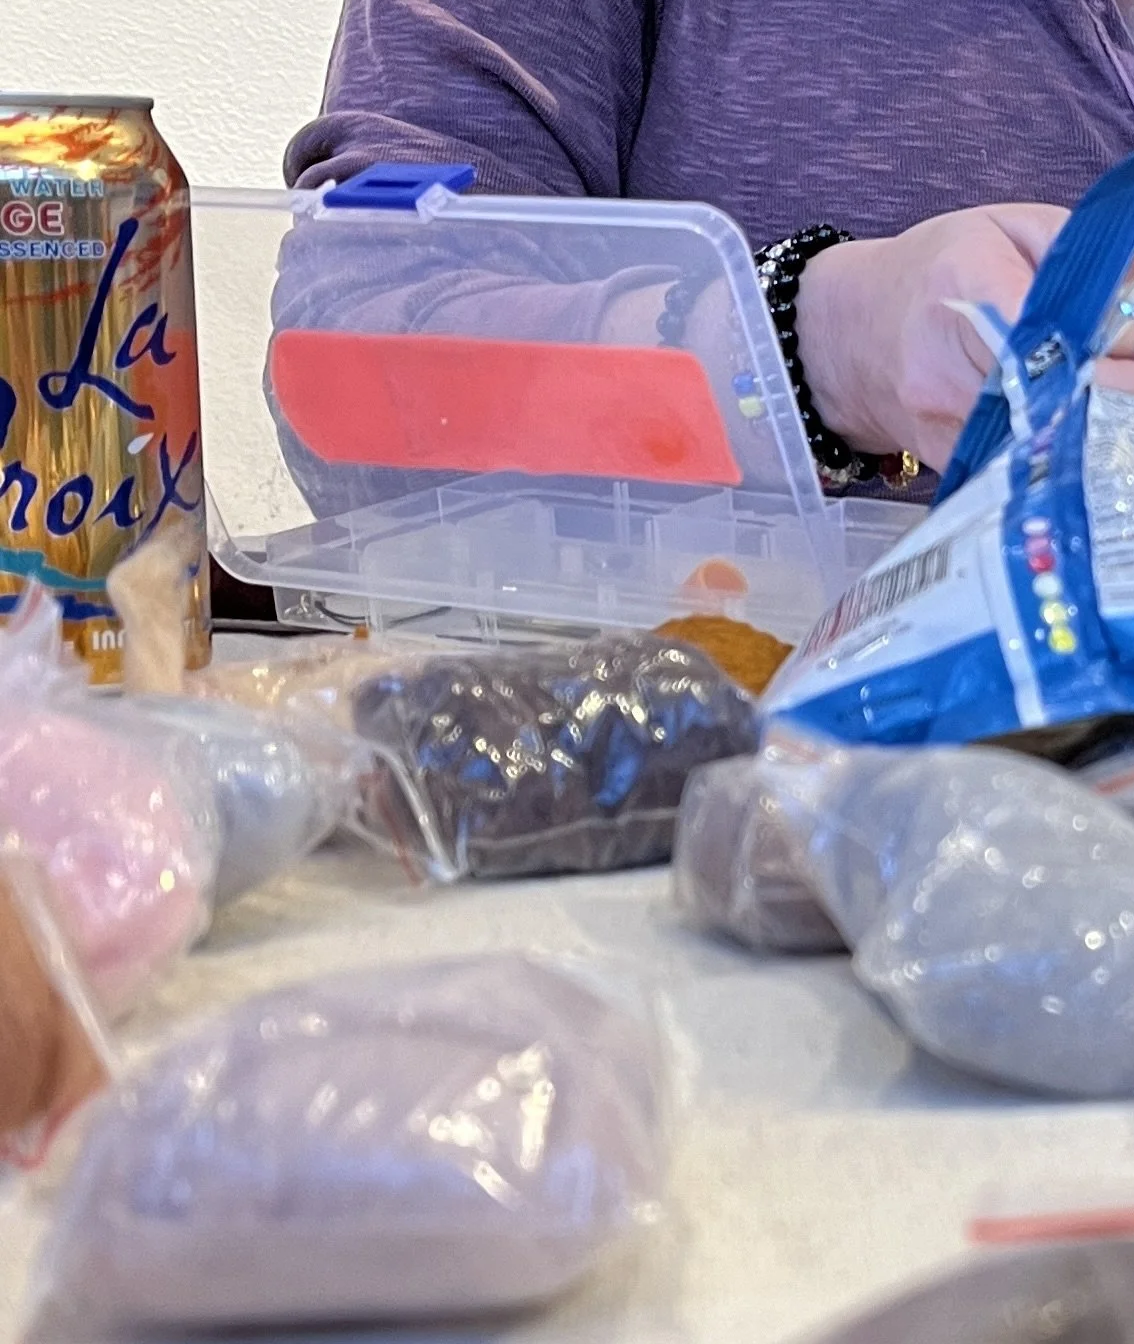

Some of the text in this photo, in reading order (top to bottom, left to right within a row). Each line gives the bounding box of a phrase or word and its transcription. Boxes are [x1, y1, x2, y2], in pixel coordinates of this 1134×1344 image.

[0, 200, 64, 236] GE
[9, 177, 104, 197] WATER
[37, 217, 176, 421] La
[0, 376, 201, 562] roix
